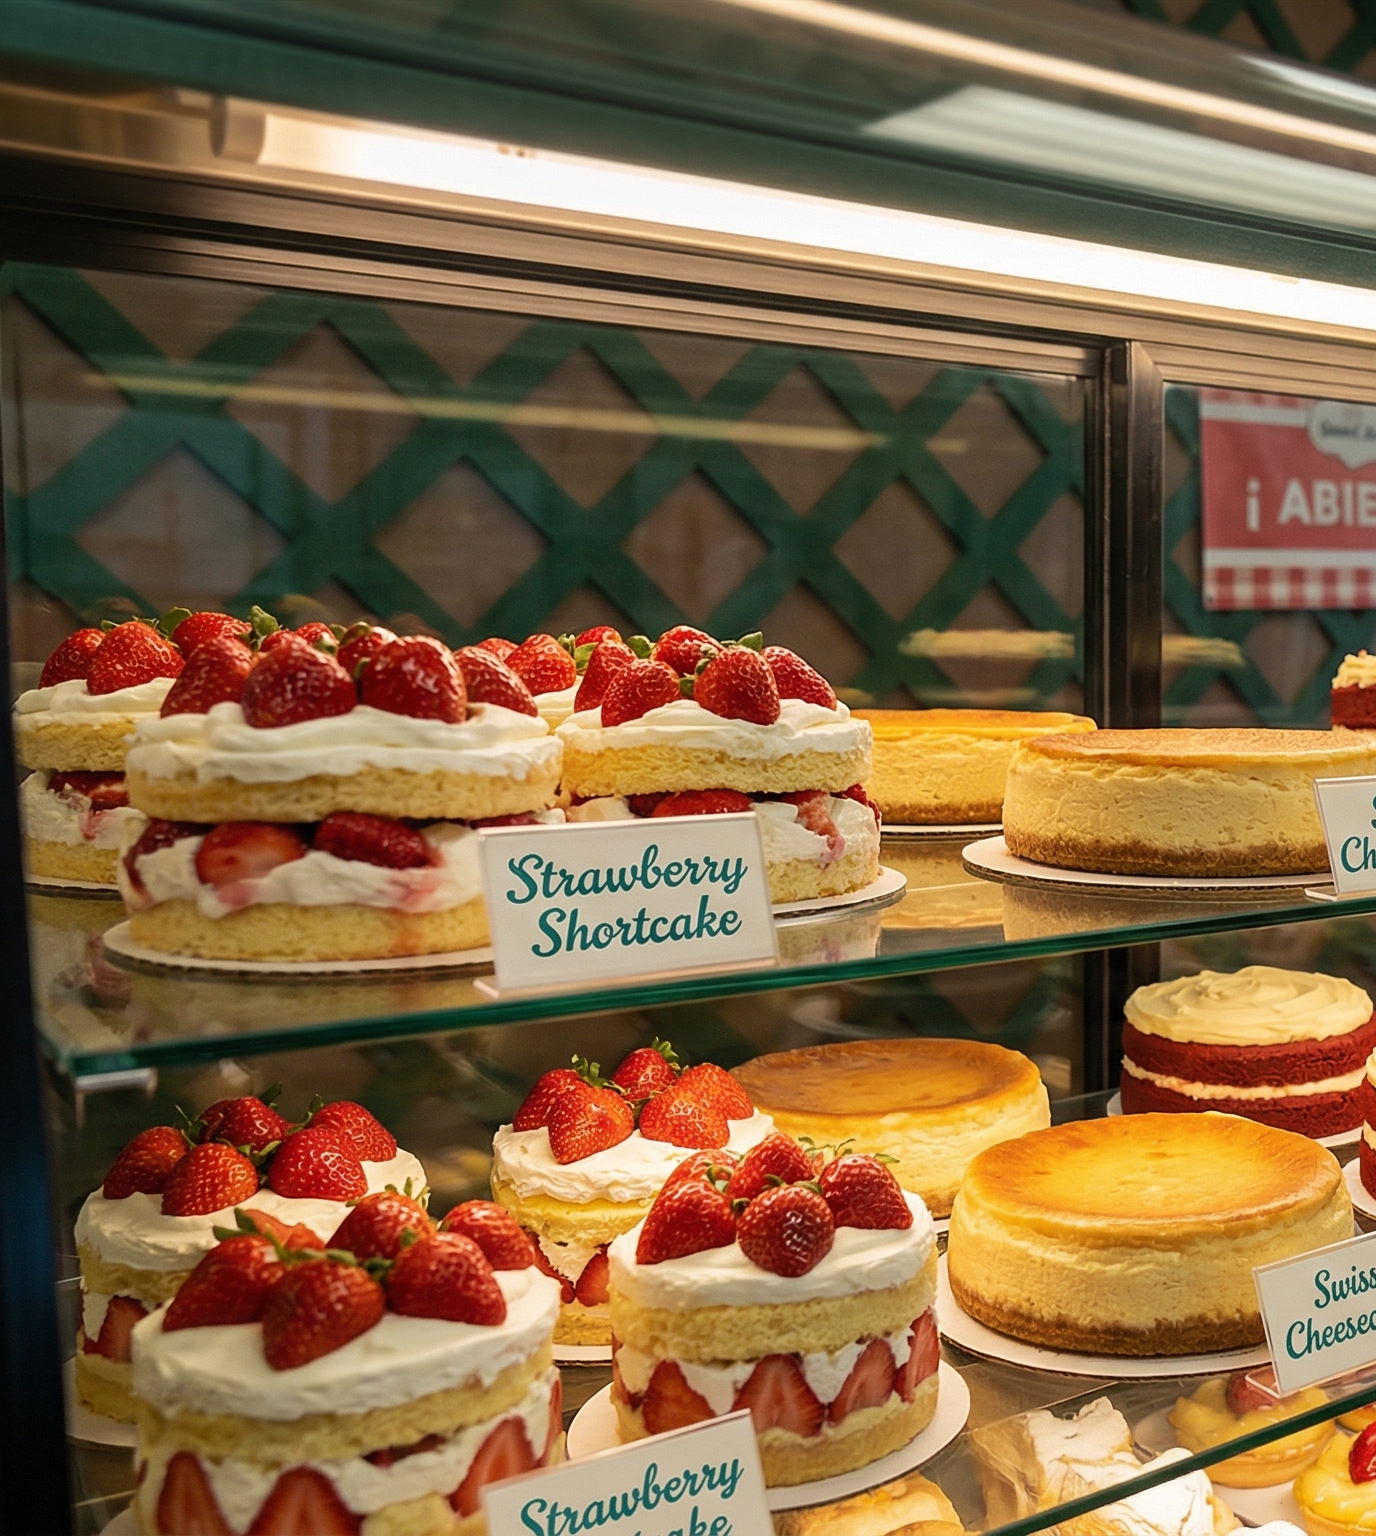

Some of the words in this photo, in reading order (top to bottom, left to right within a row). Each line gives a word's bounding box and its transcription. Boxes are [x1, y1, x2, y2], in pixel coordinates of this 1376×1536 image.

[506, 843, 749, 904] Strawberry
[531, 894, 742, 957] Shortcake
[520, 1458, 745, 1536] Strawberry
